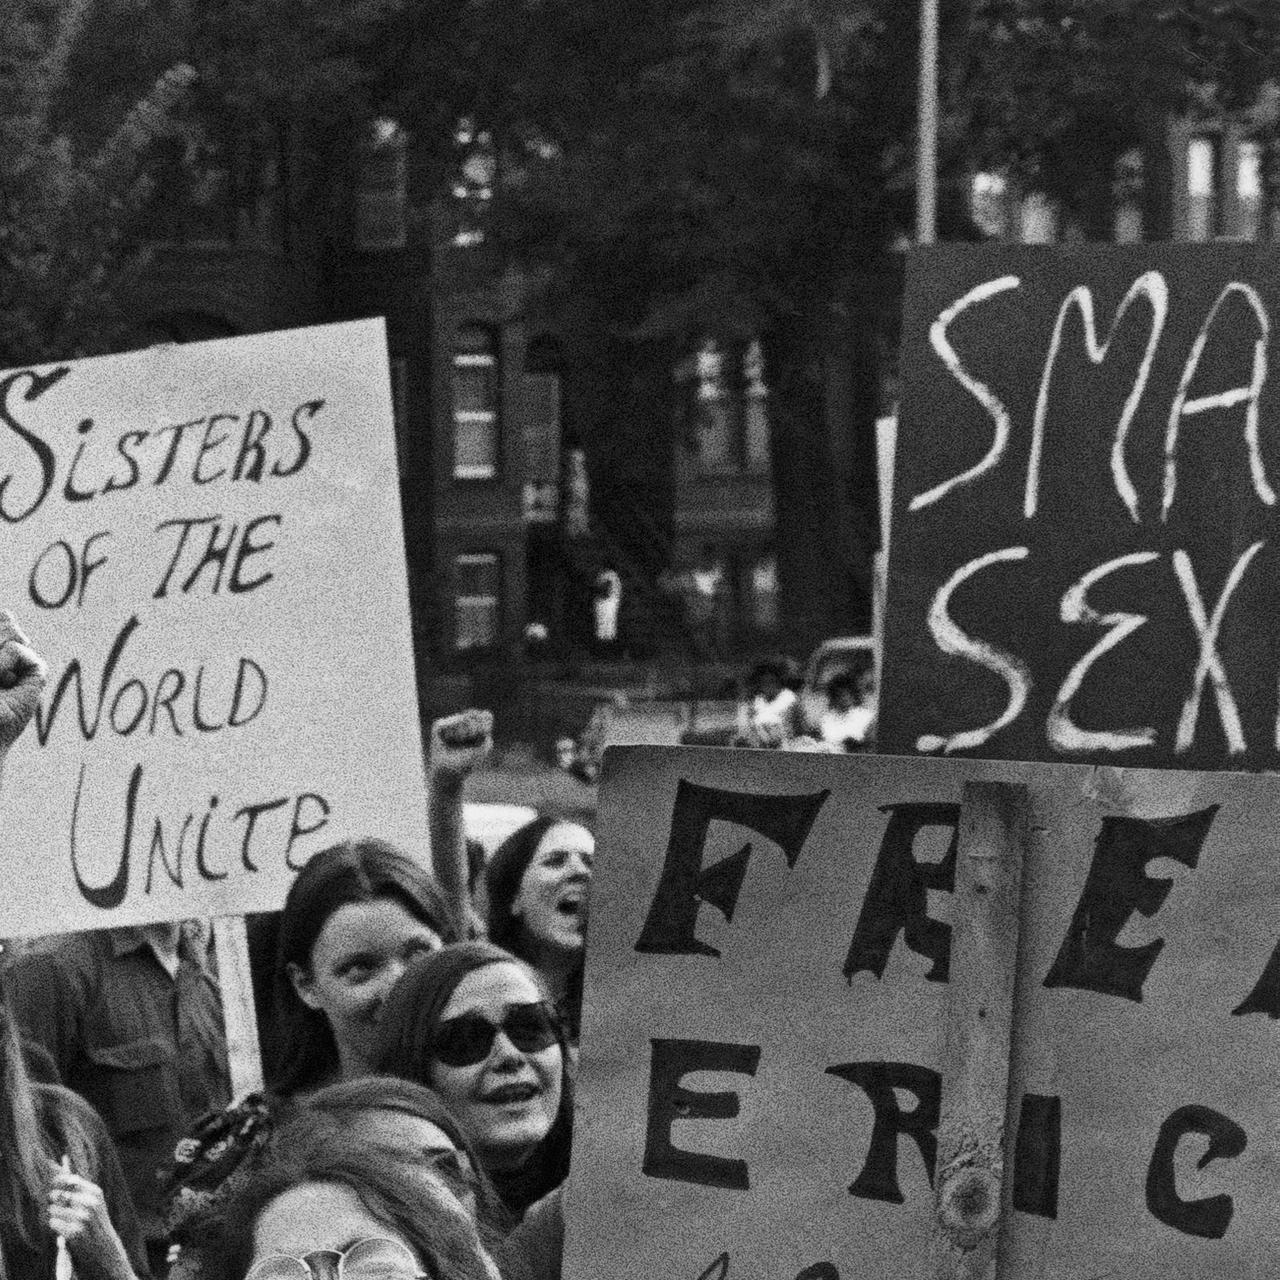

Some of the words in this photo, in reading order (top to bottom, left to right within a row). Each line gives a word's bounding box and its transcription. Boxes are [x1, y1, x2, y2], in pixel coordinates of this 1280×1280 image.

[27, 530, 112, 610] OF
[152, 514, 283, 599] THE
[36, 614, 269, 748] WORLD
[634, 778, 1280, 1020] FRE
